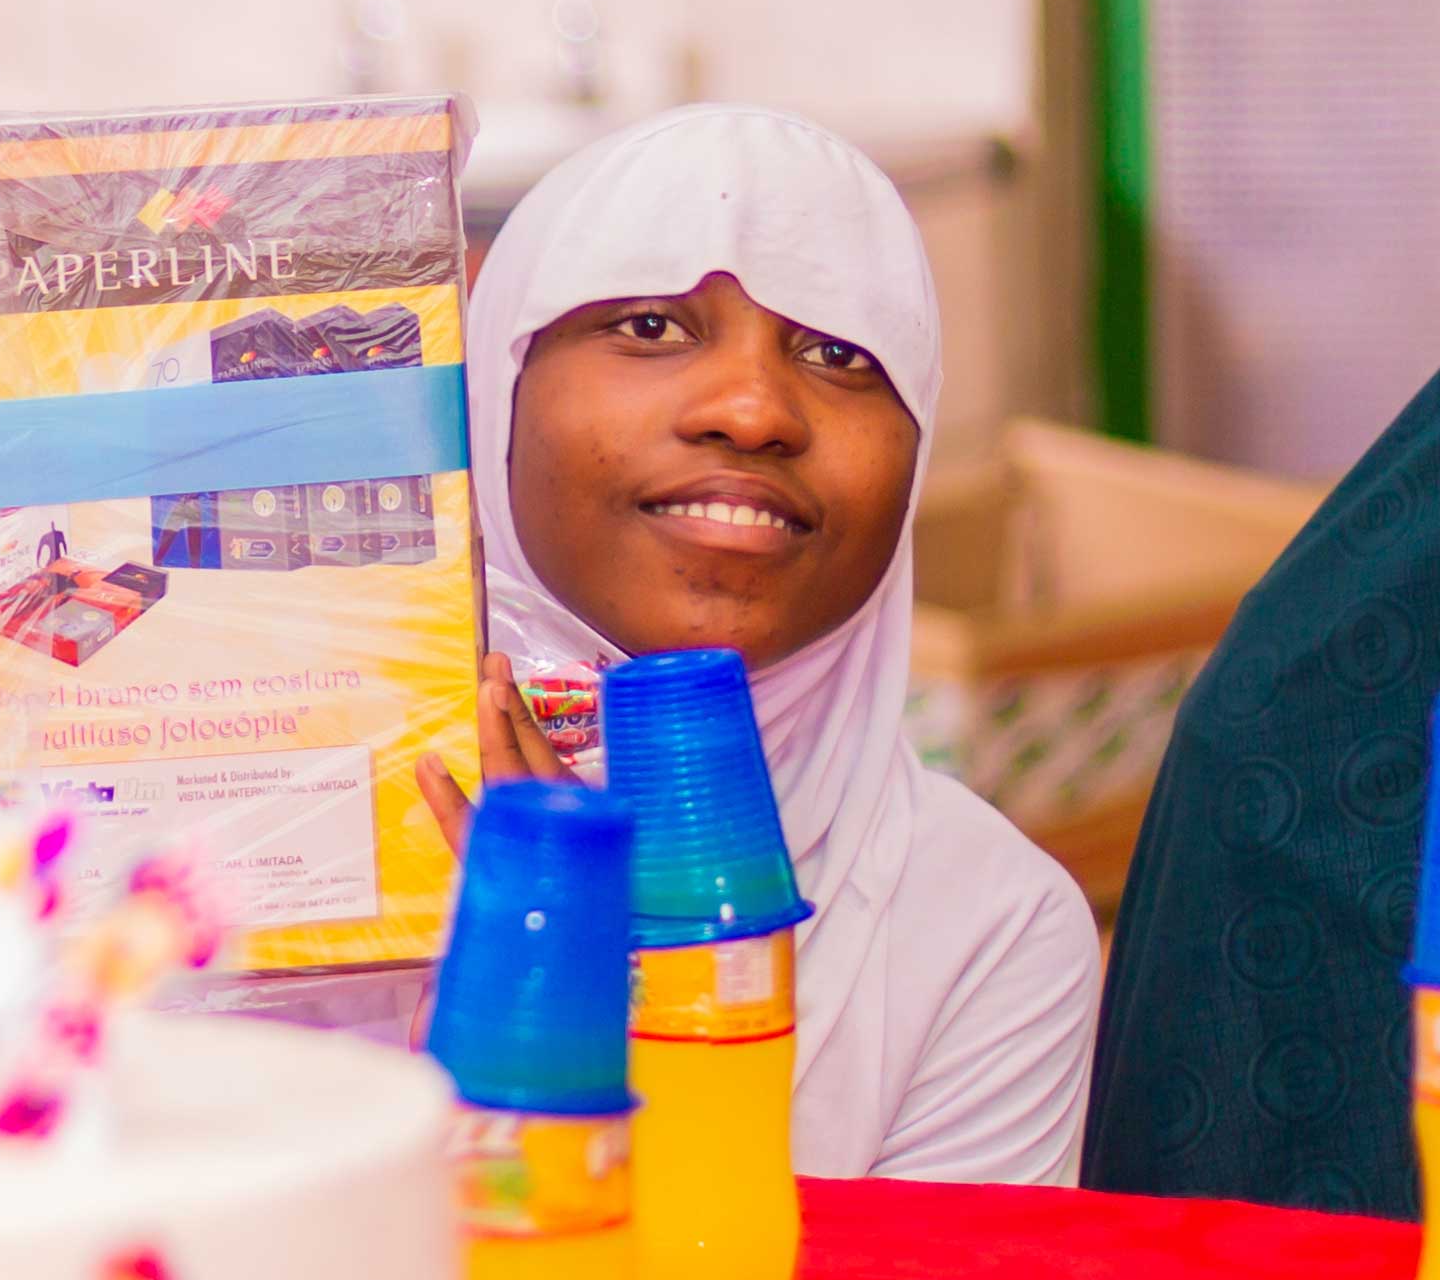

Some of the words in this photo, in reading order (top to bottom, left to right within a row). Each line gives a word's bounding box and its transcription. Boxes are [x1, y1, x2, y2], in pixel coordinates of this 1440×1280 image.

[152, 357, 180, 387] 70
[77, 683, 179, 707] branco
[188, 677, 242, 701] sem
[252, 669, 361, 694] costura
[176, 773, 218, 786] Marketed
[221, 771, 227, 783] &
[230, 768, 279, 783] Distributed
[177, 790, 206, 803] VISTA
[208, 788, 226, 801] UM
[311, 778, 359, 793] LIMITADA
[248, 854, 304, 868] LIMITADA
